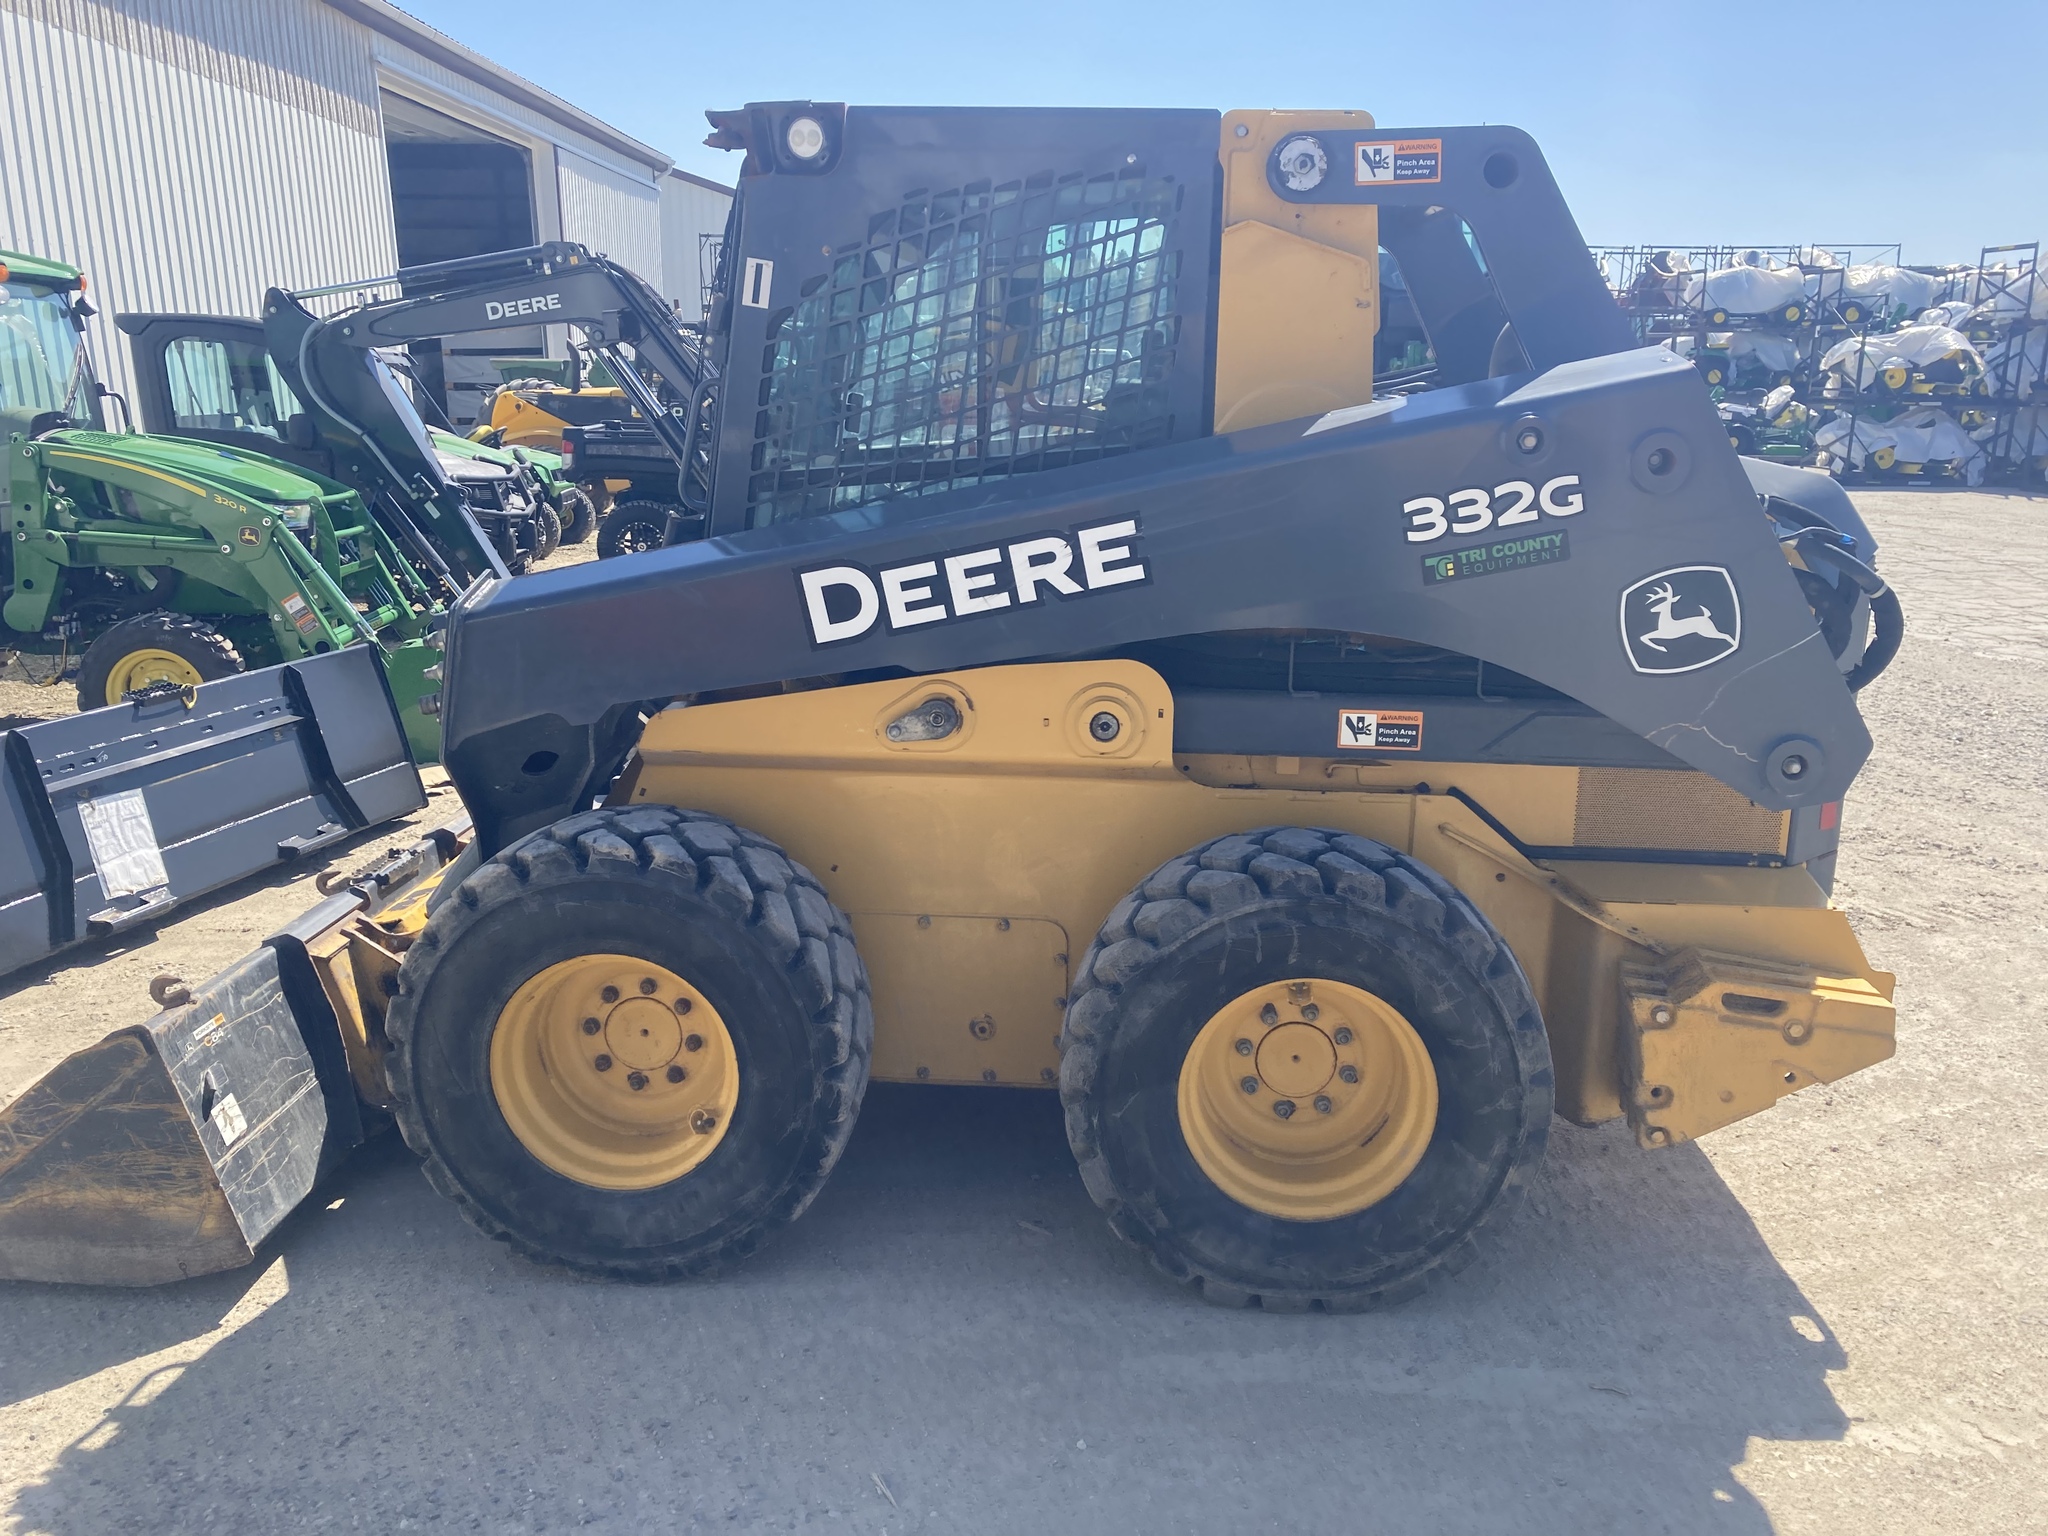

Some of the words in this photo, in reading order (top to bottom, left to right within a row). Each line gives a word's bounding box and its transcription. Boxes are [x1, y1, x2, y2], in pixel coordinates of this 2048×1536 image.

[1405, 143, 1437, 151] WARNING
[1397, 159, 1417, 167] Pinch
[1418, 158, 1436, 166] Area
[484, 293, 562, 321] DEERE
[213, 493, 237, 509] 320
[239, 504, 247, 514] R
[1403, 475, 1584, 542] 332G
[1457, 547, 1486, 564] TRI
[1492, 533, 1563, 558] COUNTY
[1462, 548, 1561, 575] EQUIPMENT
[800, 519, 1146, 644] DEERE
[1387, 714, 1419, 722] WARNING
